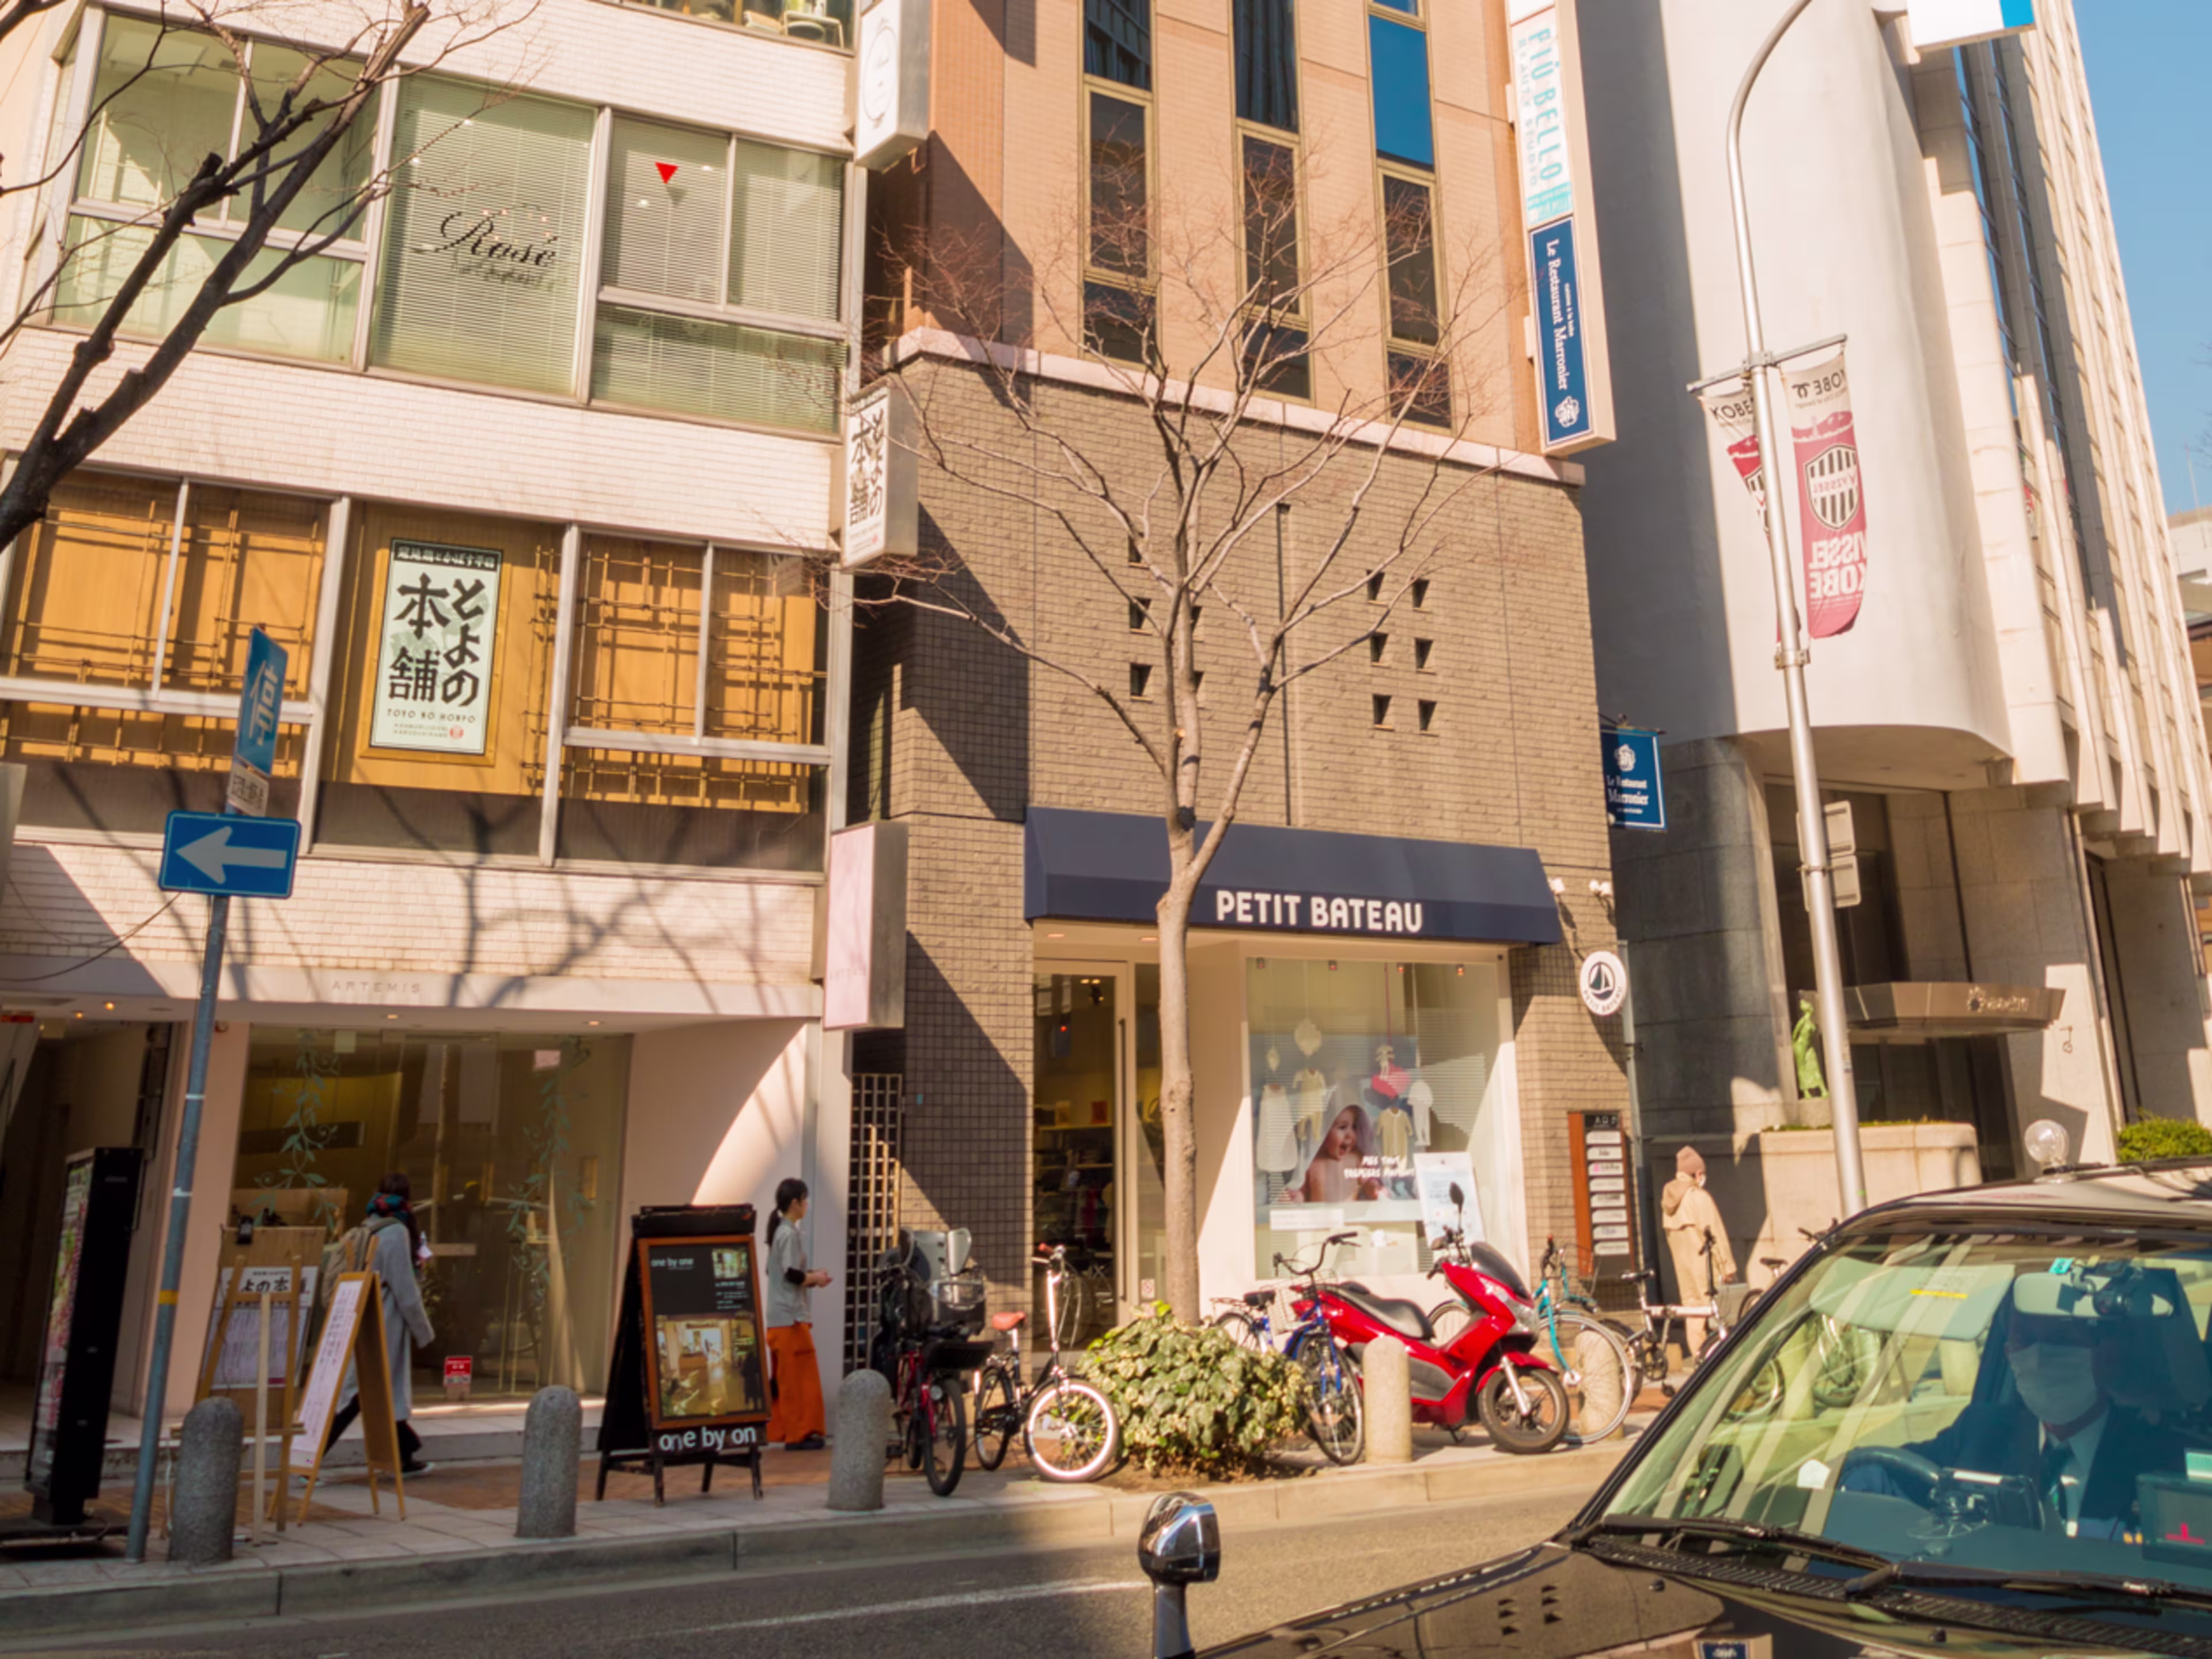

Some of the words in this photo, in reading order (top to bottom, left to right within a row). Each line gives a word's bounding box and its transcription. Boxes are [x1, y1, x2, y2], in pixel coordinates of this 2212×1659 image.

[1533, 87, 1562, 181] BELLO
[1547, 238, 1560, 257] Le
[1548, 257, 1564, 325] Restaurant
[1554, 325, 1570, 391] Marronier
[388, 571, 452, 703] 本舗
[441, 578, 486, 707] とよの
[249, 660, 279, 747] 停
[387, 708, 416, 719] TOYO
[421, 711, 436, 720] NO
[440, 713, 476, 724] HONPO
[1217, 890, 1301, 926] PETIT
[1310, 896, 1423, 933] BATEAU
[331, 981, 421, 994] ARTEMIS
[666, 1257, 677, 1268] by
[659, 1430, 696, 1451] one
[701, 1426, 726, 1452] by
[731, 1426, 756, 1445] on
